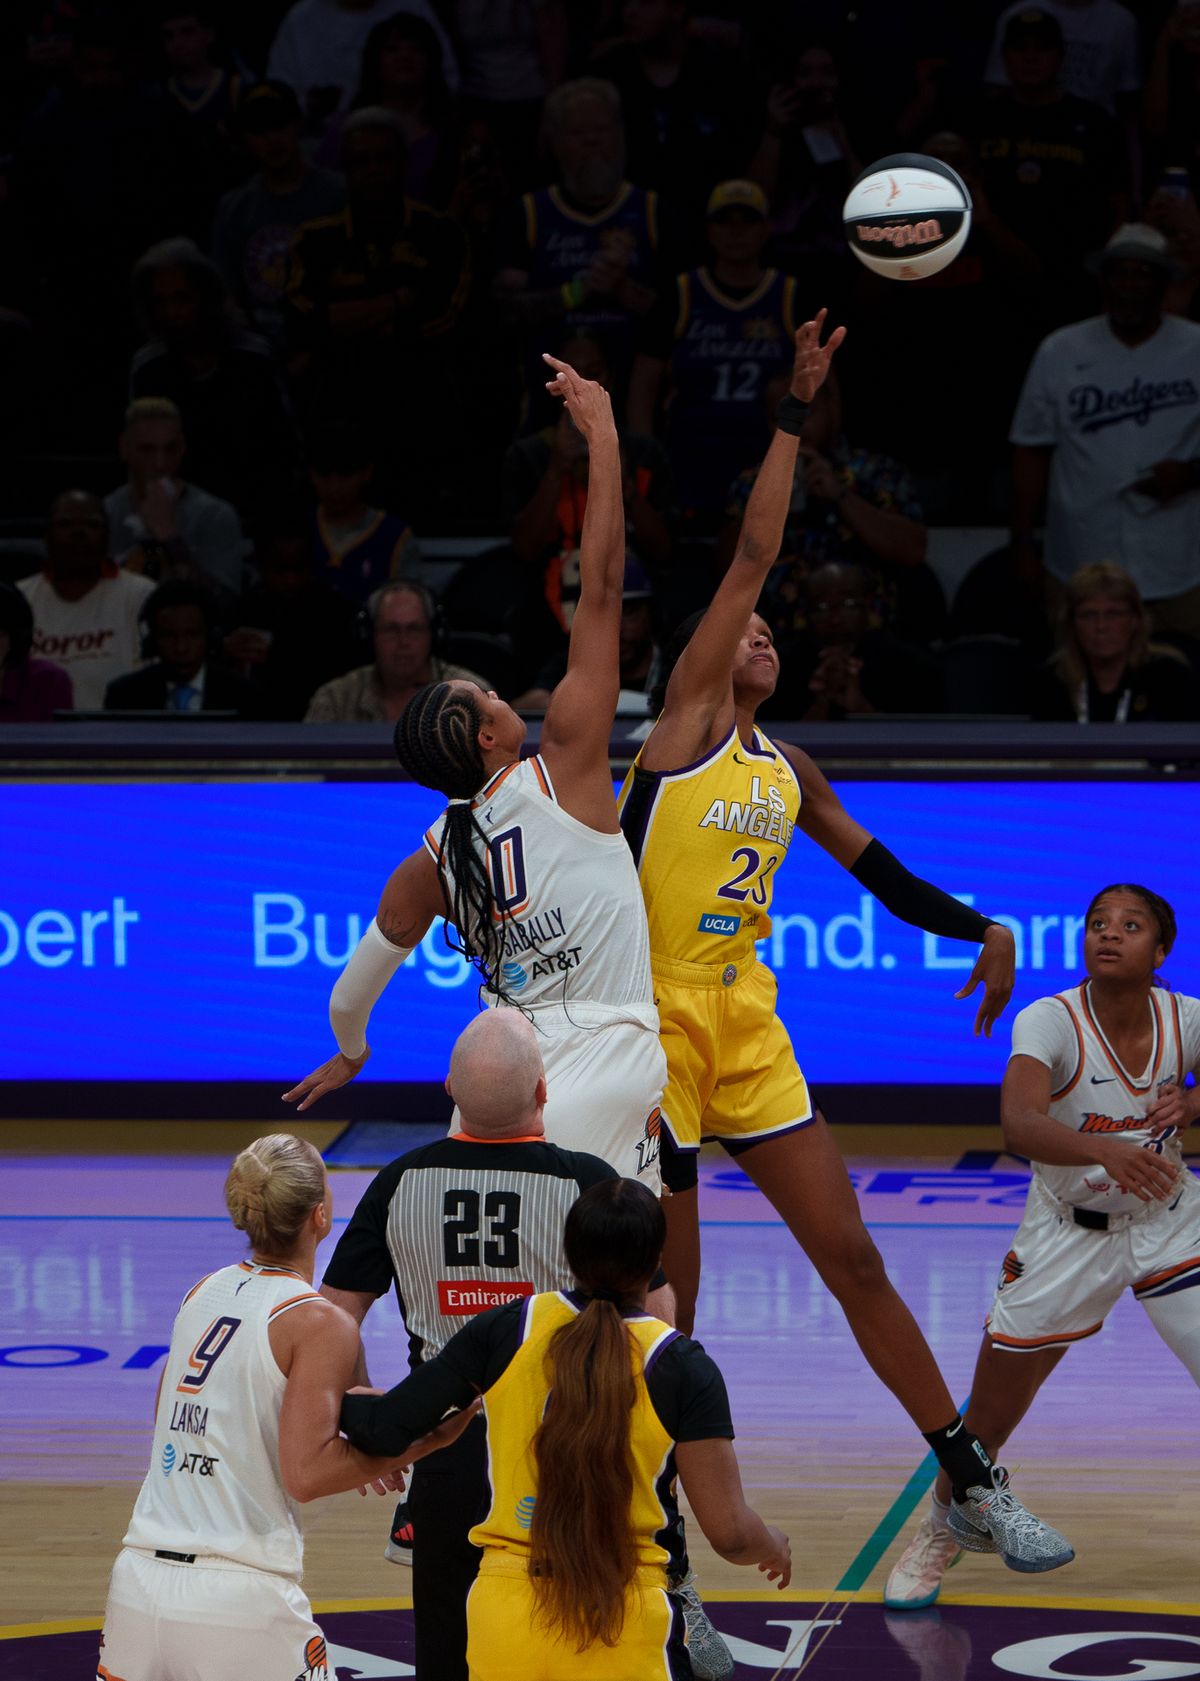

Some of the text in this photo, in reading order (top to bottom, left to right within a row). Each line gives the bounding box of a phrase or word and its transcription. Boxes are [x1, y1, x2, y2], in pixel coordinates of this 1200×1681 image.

[856, 219, 944, 248] Wilson
[710, 361, 763, 402] 12
[1069, 376, 1198, 427] Dodgers
[498, 907, 567, 958] SABALLY
[704, 917, 735, 933] UCLA
[532, 947, 582, 980] AT&T
[444, 1189, 521, 1268] 23
[176, 1316, 242, 1394] 9
[170, 1402, 208, 1436] LAKSA
[179, 1453, 219, 1476] AT&T
